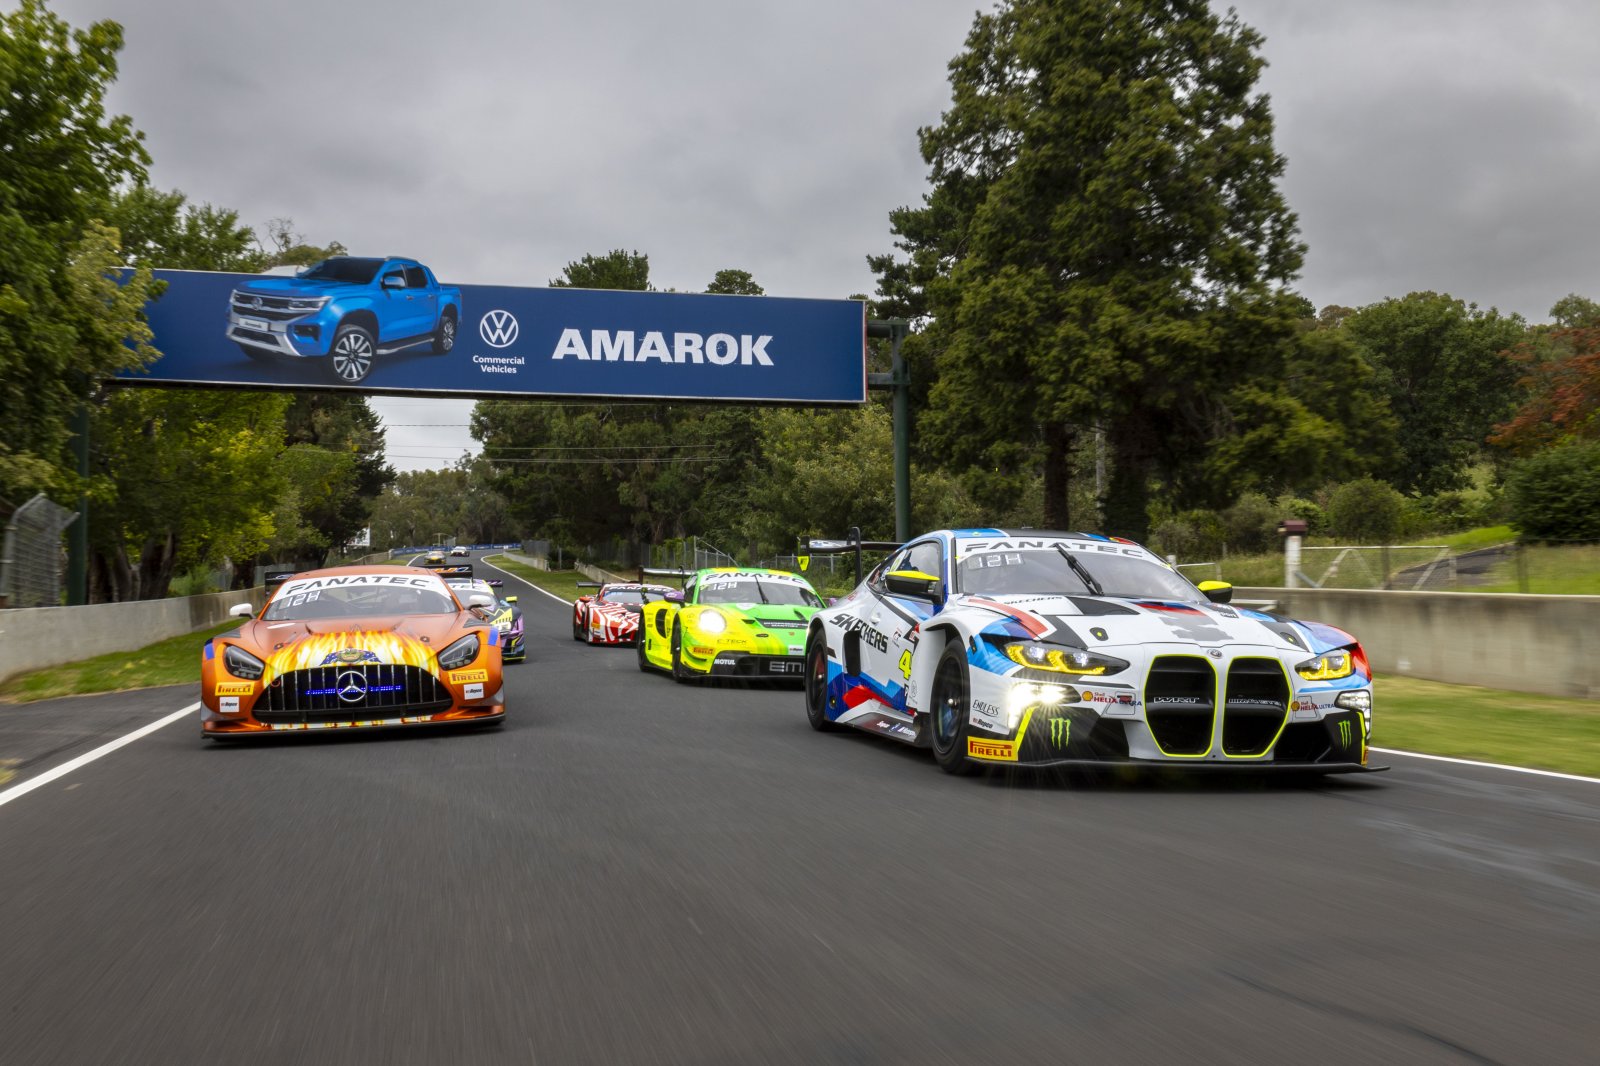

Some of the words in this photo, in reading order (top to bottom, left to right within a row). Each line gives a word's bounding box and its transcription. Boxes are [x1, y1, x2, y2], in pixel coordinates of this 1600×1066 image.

[552, 328, 774, 366] AMAROK
[472, 355, 525, 365] Commercial
[480, 364, 517, 374] Vehicles
[965, 541, 1143, 558] FANATEC
[705, 572, 804, 585] FANATEC
[287, 576, 430, 595] FANATEC
[712, 582, 738, 591] 12H
[287, 591, 320, 607] 12H
[829, 613, 888, 654] SKECHERS
[714, 658, 735, 666] MOTUL
[770, 661, 804, 673] EM
[452, 671, 485, 682] PIRELLI
[218, 684, 251, 693] PIRELLI
[1093, 696, 1119, 704] HELIX
[972, 699, 999, 716] ENDLESS
[970, 741, 1013, 758] PIRELLI
